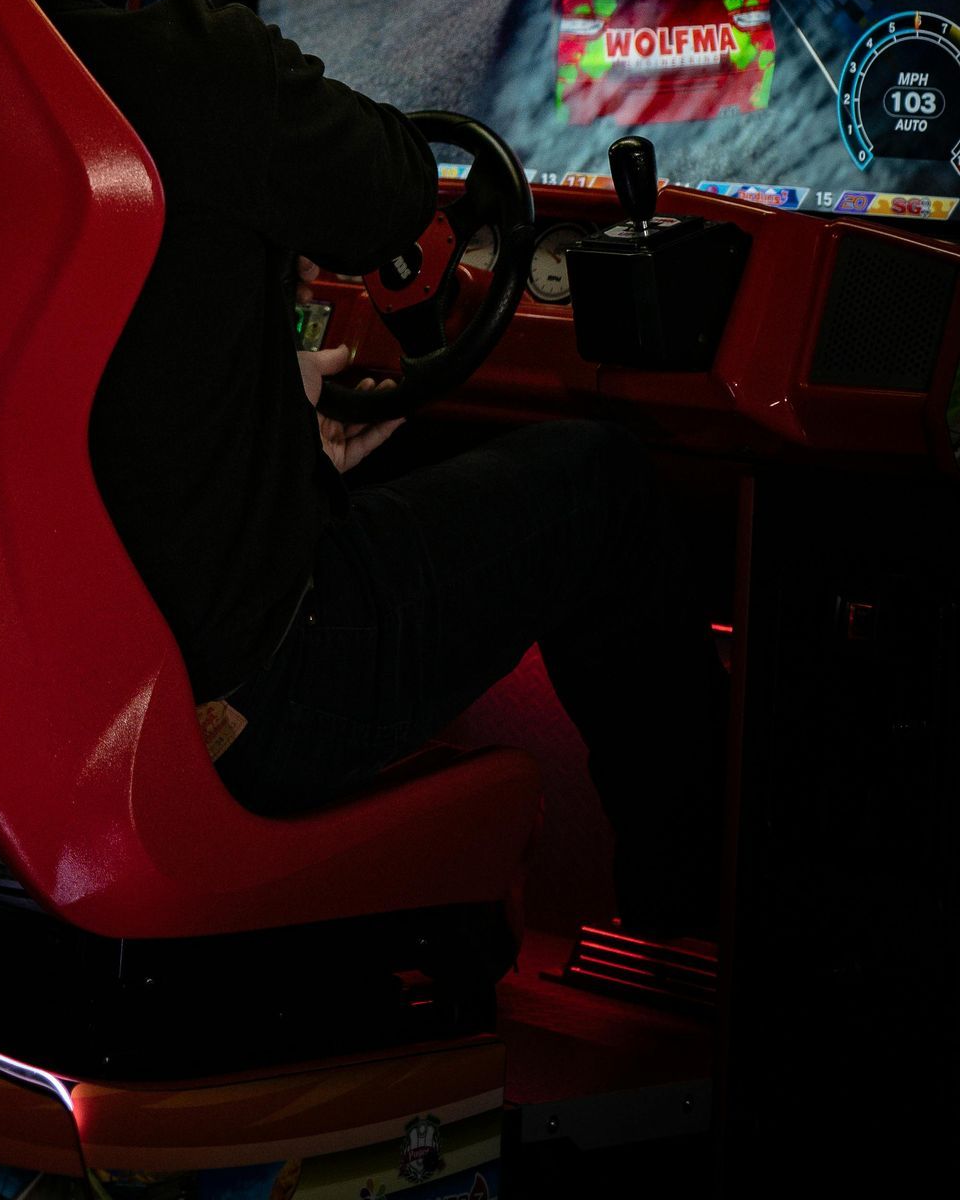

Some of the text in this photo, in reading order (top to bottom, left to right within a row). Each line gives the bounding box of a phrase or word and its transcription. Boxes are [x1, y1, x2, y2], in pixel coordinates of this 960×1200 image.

[888, 22, 896, 34] 5
[941, 22, 949, 34] 7
[605, 23, 739, 60] WOLFMA
[865, 37, 874, 49] 4
[849, 61, 858, 74] 3
[897, 71, 930, 87] MPH
[843, 93, 851, 105] 2
[891, 90, 937, 114] 103
[847, 124, 853, 136] 1
[895, 118, 928, 133] AUTO
[858, 150, 866, 162] 0
[815, 191, 833, 207] 15
[840, 195, 869, 210] 20
